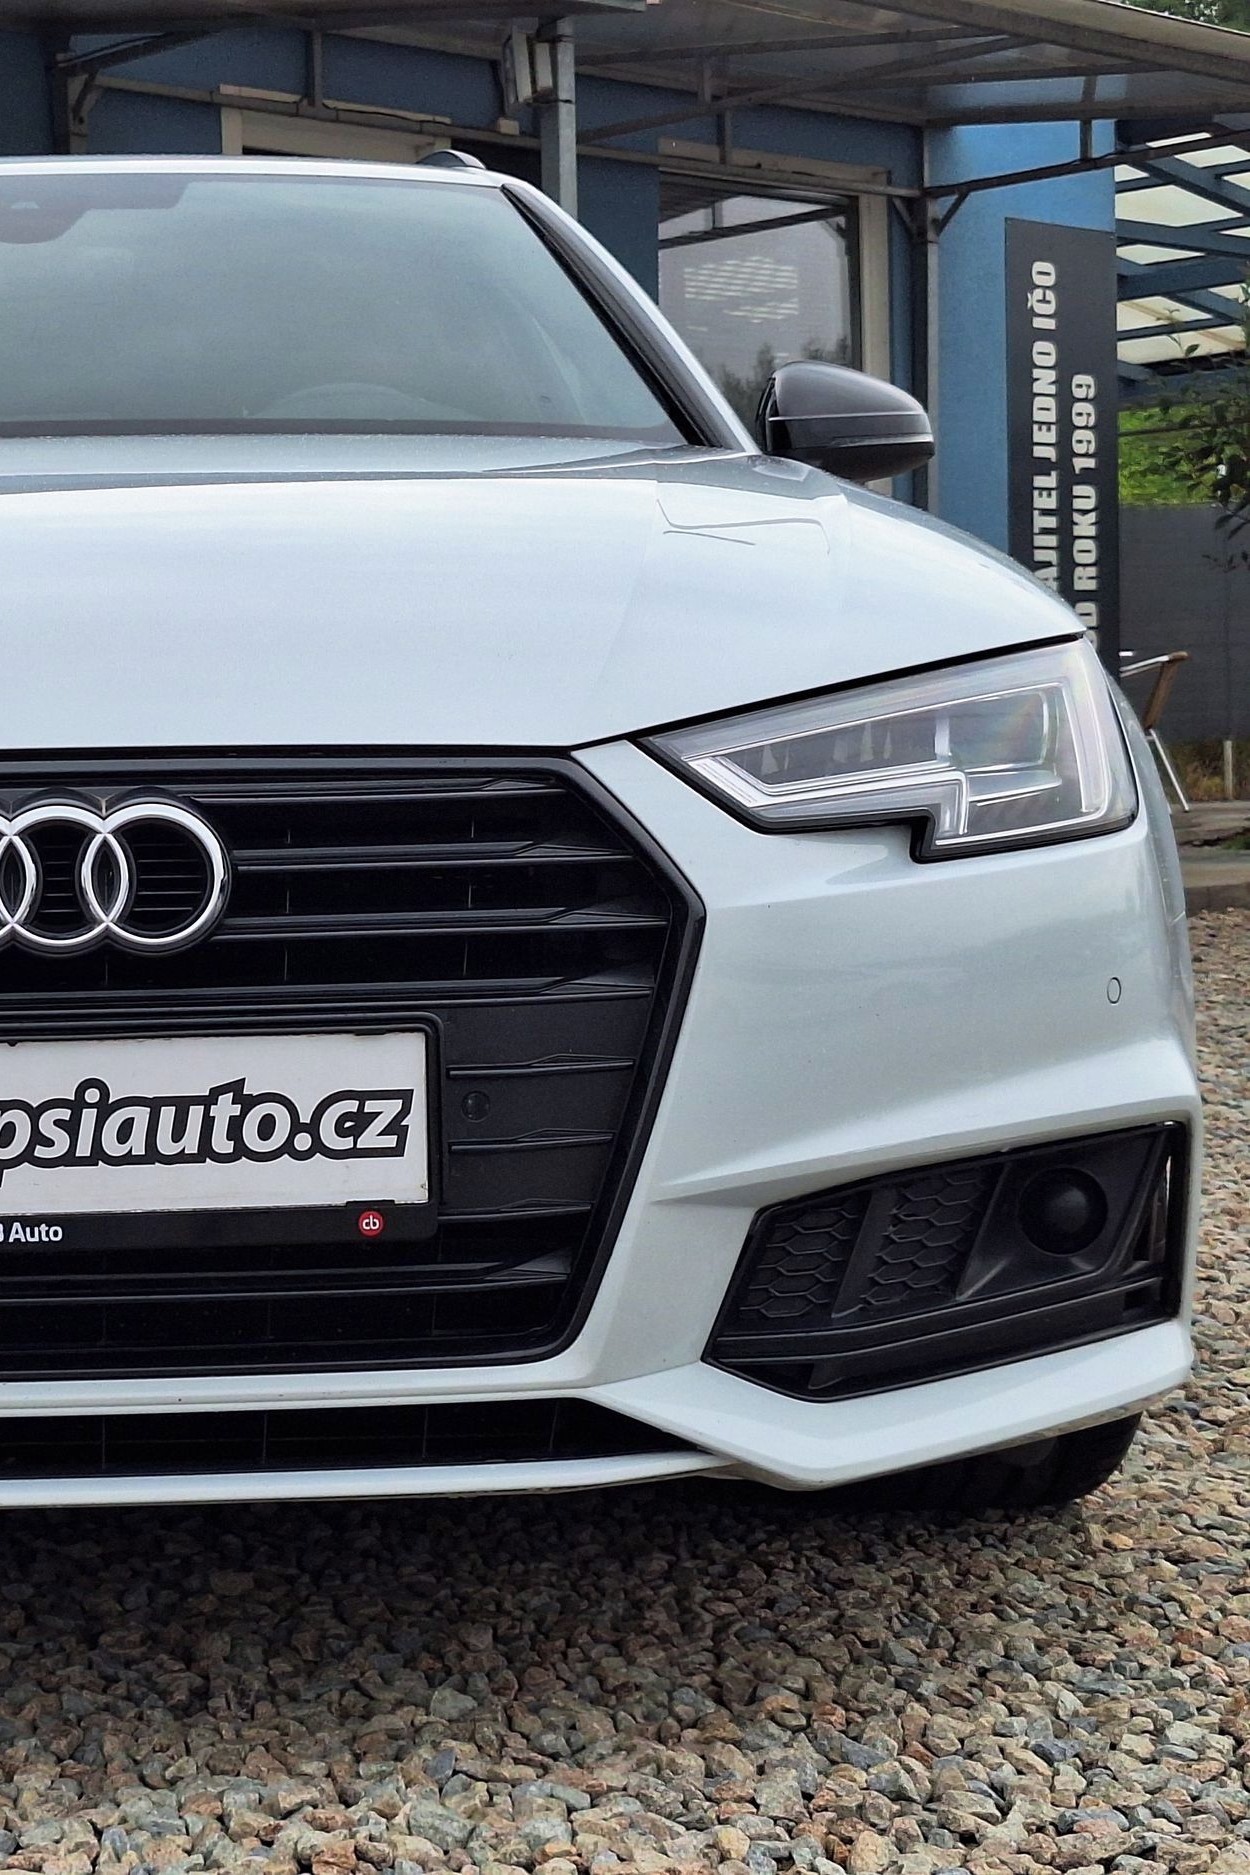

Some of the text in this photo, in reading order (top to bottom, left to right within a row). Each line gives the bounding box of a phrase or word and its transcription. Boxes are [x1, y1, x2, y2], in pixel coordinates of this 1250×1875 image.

[1027, 261, 1056, 329] IČO
[1032, 341, 1056, 462] JEDNO
[1071, 374, 1097, 650] D ROKU 1999
[9, 1222, 63, 1243] Auto
